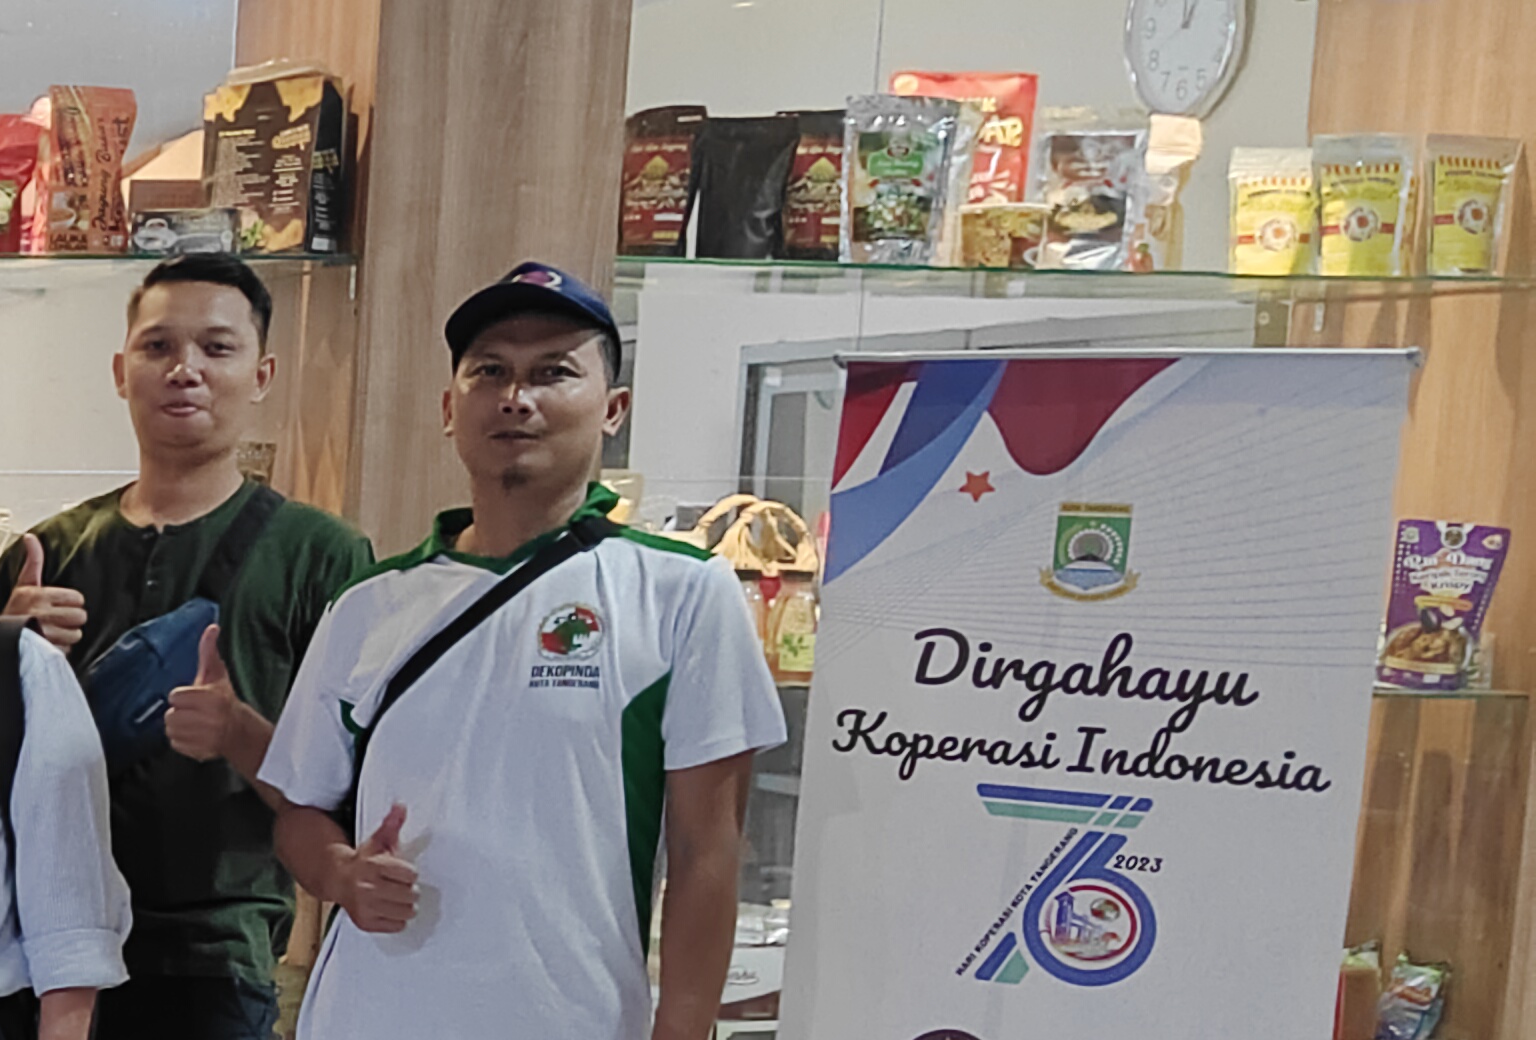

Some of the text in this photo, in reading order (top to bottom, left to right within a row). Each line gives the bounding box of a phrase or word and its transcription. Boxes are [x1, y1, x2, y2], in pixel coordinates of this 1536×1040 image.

[1149, 49, 1159, 72] 8
[1176, 80, 1188, 101] 6
[531, 665, 600, 677] DEKOPINDA
[914, 628, 1259, 733] Dirgahayu
[832, 709, 1331, 792] Koperasi Indonesia
[1113, 854, 1163, 873] 2023
[955, 827, 1078, 976] HARI KOPERASI KOTA TANGERANG
